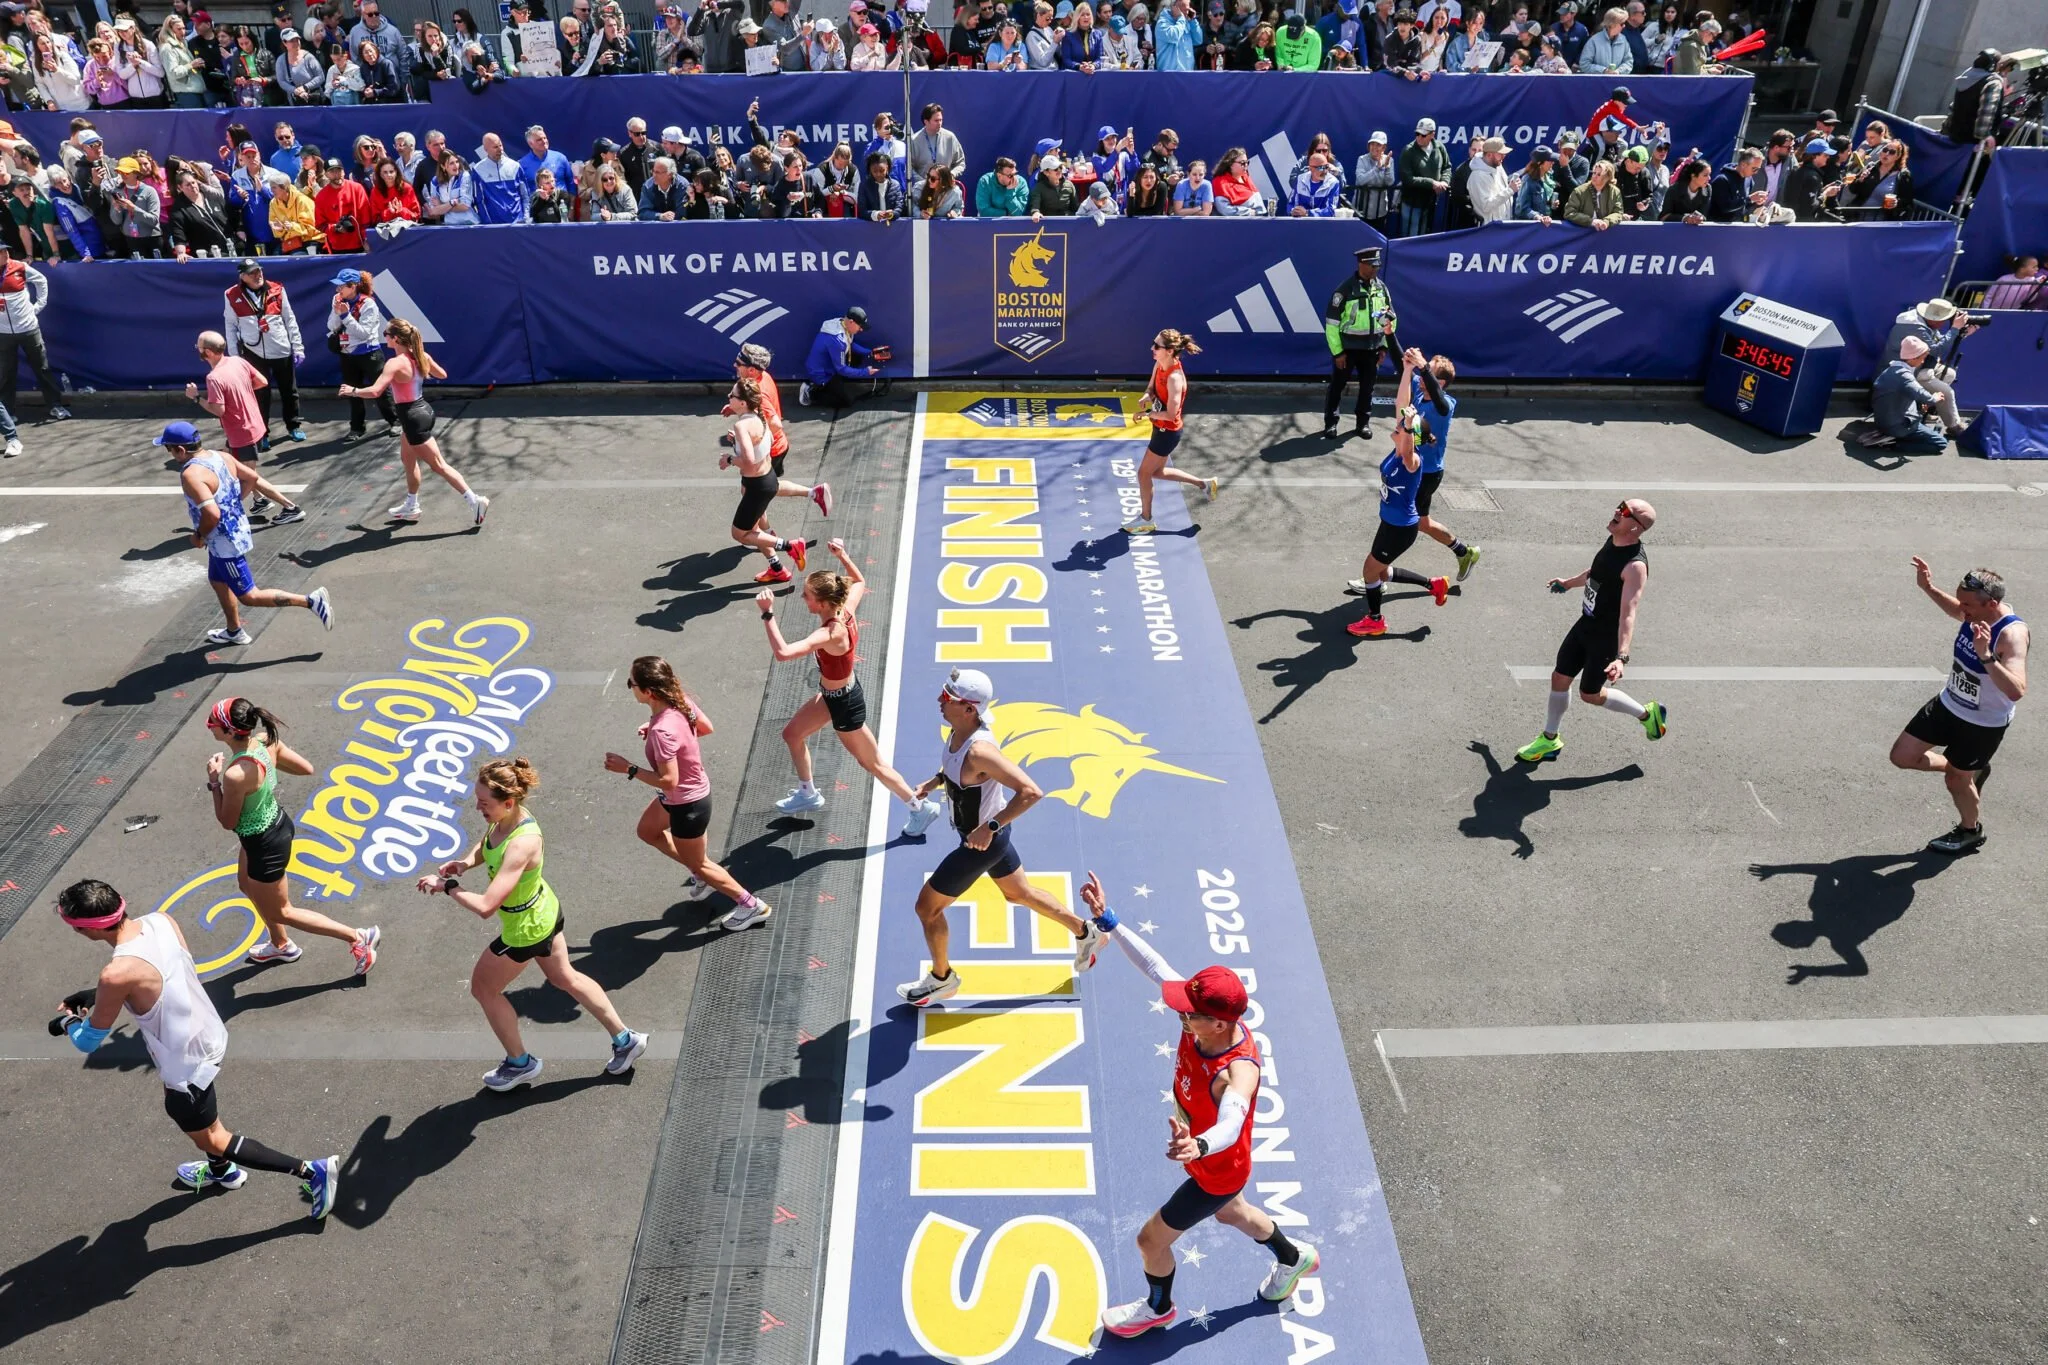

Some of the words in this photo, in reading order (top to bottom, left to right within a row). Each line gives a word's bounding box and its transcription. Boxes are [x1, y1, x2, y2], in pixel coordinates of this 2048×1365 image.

[688, 126, 744, 145] ANK
[795, 123, 914, 142] AMERI
[1436, 125, 1509, 144] BANK
[1514, 125, 1549, 144] OF
[1553, 124, 1672, 145] AMICA
[593, 254, 678, 276] BANK
[685, 253, 724, 275] OF
[731, 251, 873, 274] AMERICA
[1447, 252, 1530, 274] BANK
[1537, 253, 1577, 275] OF
[1580, 254, 1716, 276] AMERICA
[997, 292, 1063, 306] BOSTON
[997, 307, 1063, 318] MARATHON
[1753, 306, 1780, 319] BOSTON
[1780, 313, 1818, 332] MARATHON
[1734, 339, 1794, 376] 3:46:45
[1030, 399, 1049, 427] BOSTON
[1111, 458, 1138, 484] 129TH
[1117, 487, 1155, 547] BOSN
[935, 457, 1053, 662] FINISH
[1131, 551, 1183, 661] MARATHON
[1951, 671, 1978, 698] 11295
[397, 668, 551, 795] Meet
[361, 795, 461, 876] the
[305, 886, 318, 897] TM
[1195, 868, 1251, 956] 2025
[1255, 1180, 1337, 1365] MRA
